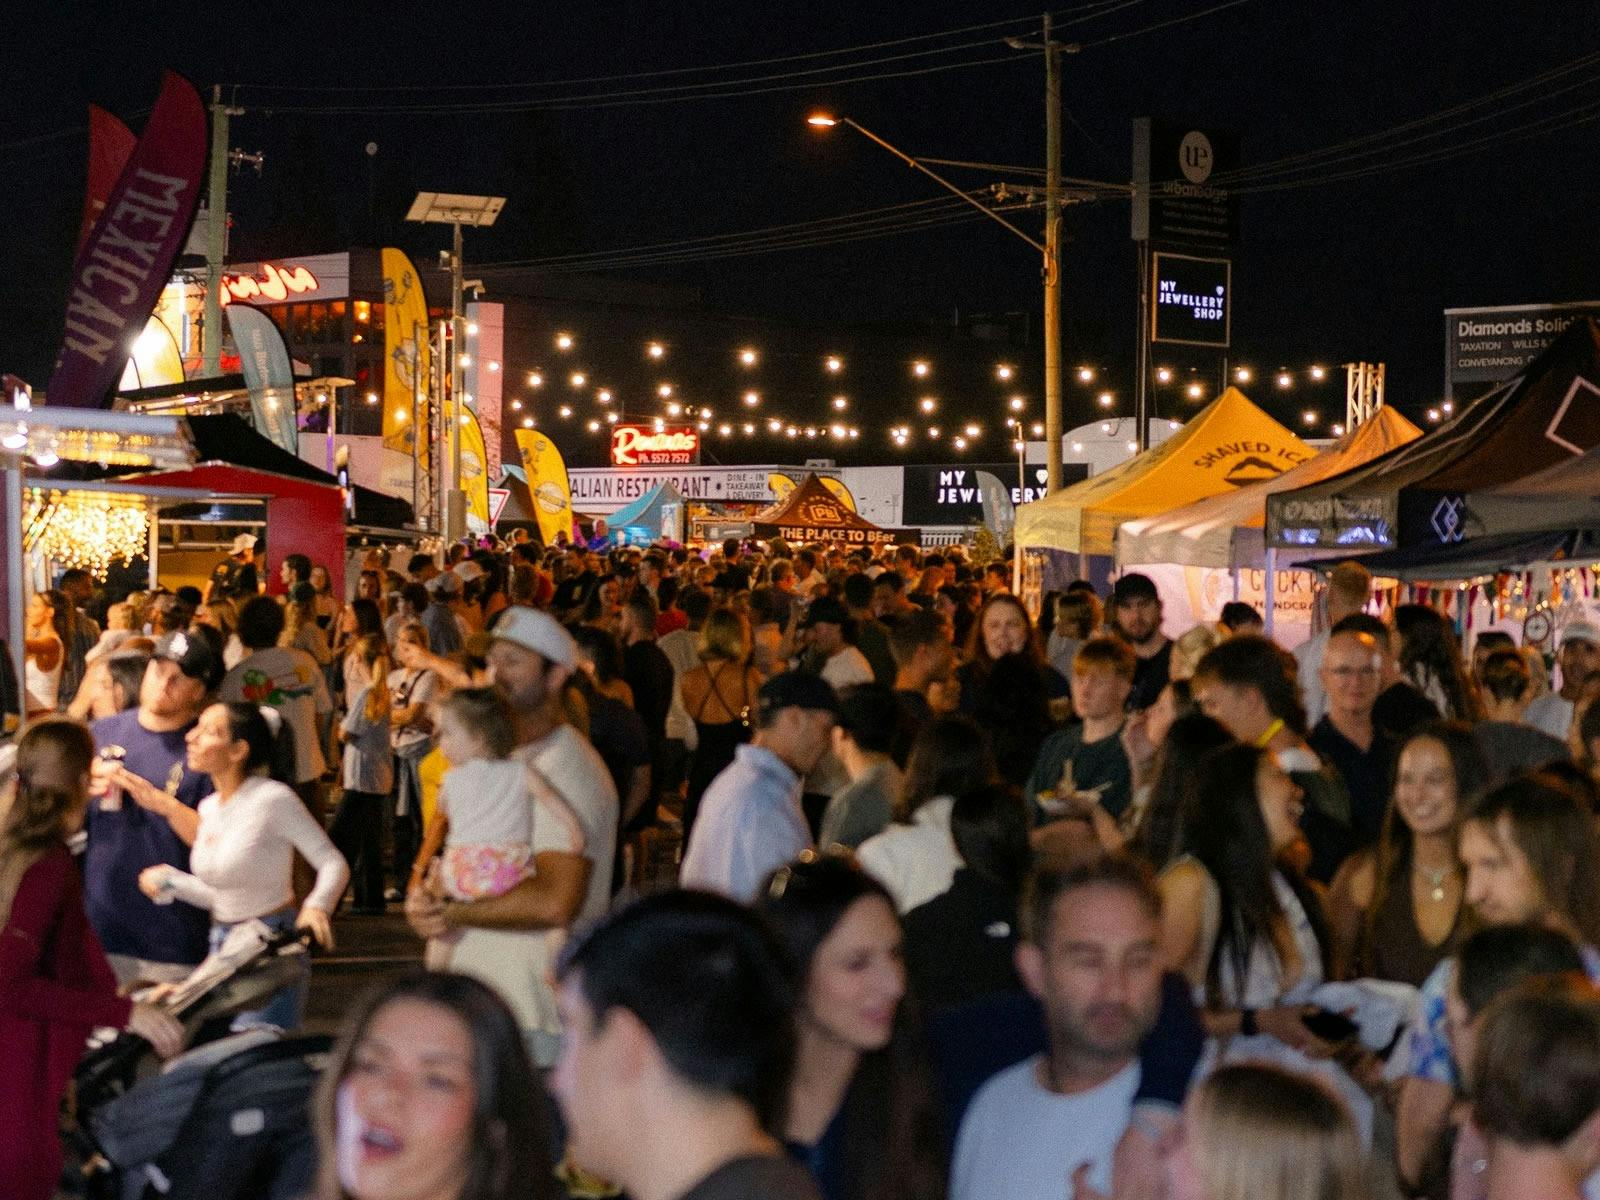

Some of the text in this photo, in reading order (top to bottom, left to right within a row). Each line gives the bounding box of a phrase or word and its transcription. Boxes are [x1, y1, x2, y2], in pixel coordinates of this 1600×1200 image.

[64, 167, 189, 366] MEXICAN
[1160, 280, 1177, 292] MY
[1159, 292, 1224, 308] JEWELLERY
[1194, 307, 1224, 320] SHOP
[1458, 316, 1575, 337] Diamonds Solic
[1460, 341, 1502, 352] TAXATION
[1511, 338, 1540, 350] WILLS
[1458, 356, 1523, 368] CONVEYANCING
[1194, 441, 1270, 469] SHAVED
[727, 473, 746, 481] DINE
[755, 473, 765, 481] IN
[939, 470, 966, 486] MY
[568, 477, 711, 498] ALIAN RESTARANT
[726, 482, 765, 490] TAKEAWAY
[937, 487, 1048, 504] JEWEERY
[778, 526, 896, 544] THE PLACE TO BEer
[1254, 599, 1313, 610] HNDCR
